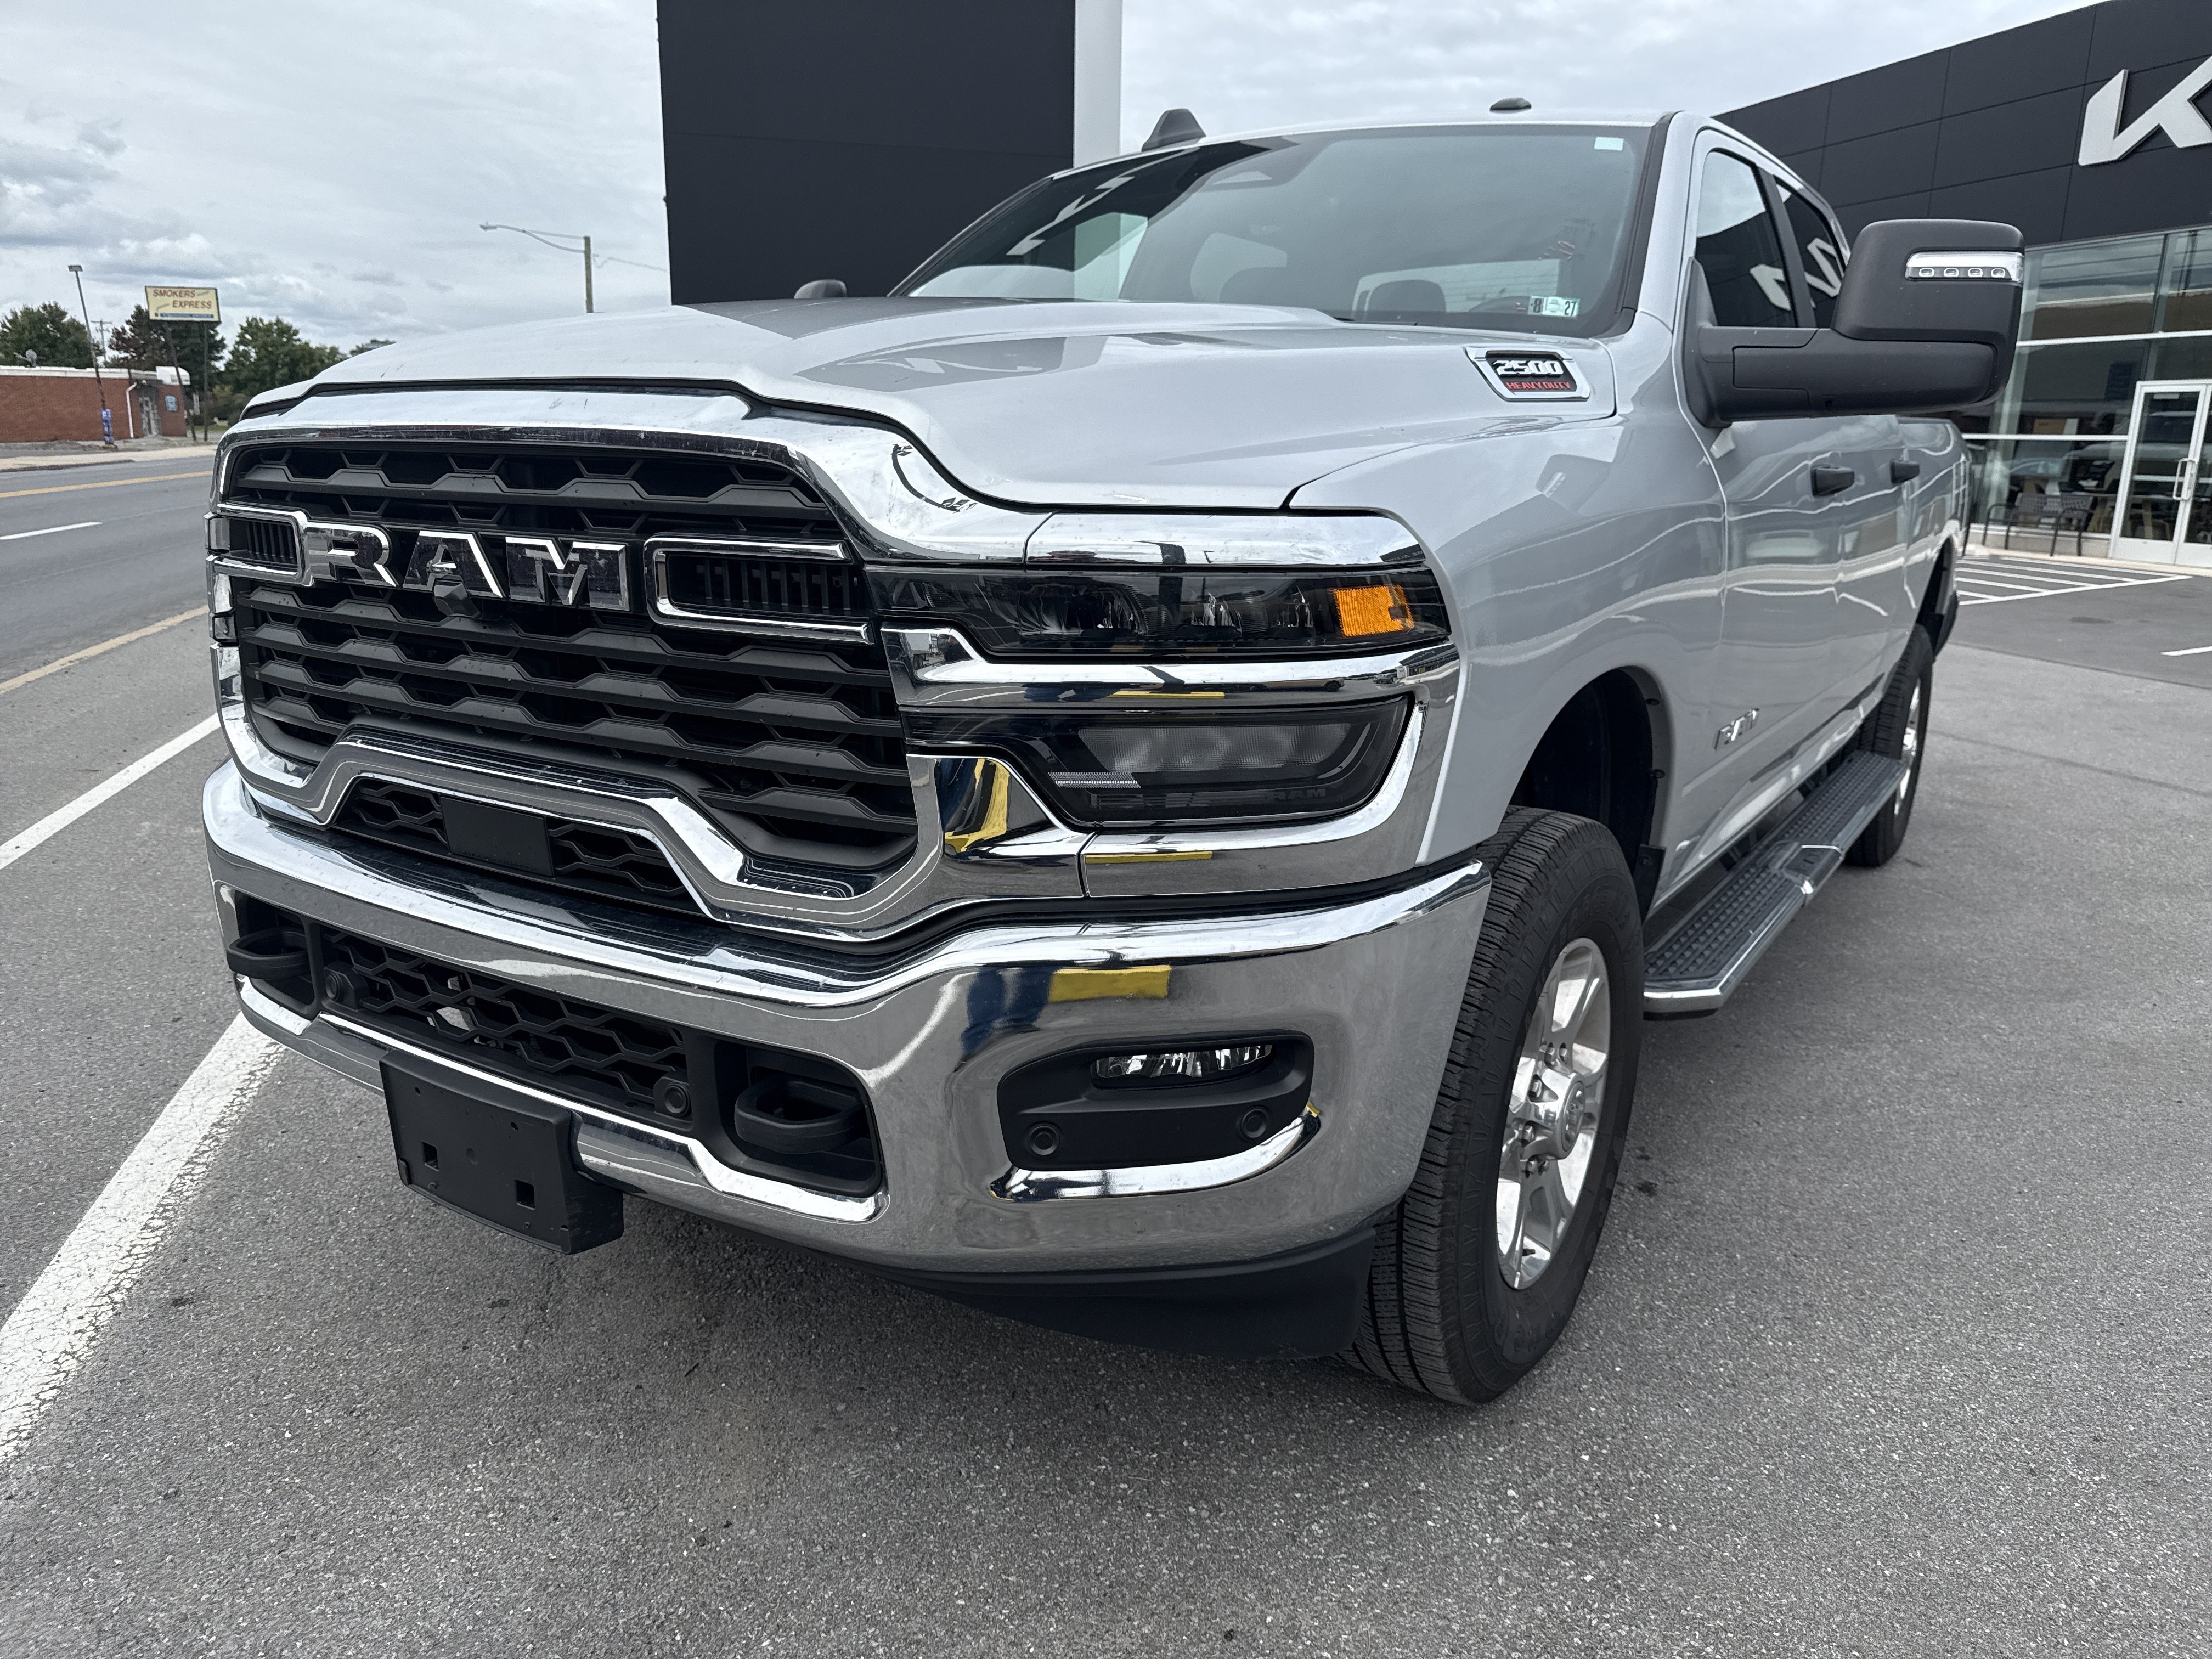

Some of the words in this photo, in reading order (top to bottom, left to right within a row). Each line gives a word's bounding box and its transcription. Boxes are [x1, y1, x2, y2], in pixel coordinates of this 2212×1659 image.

[153, 289, 196, 298] SMOKERS
[172, 300, 212, 309] EXPRESS
[1533, 298, 1543, 313] 8
[1564, 301, 1576, 317] 27
[1492, 359, 1564, 377] 2500
[1505, 381, 1543, 390] HEAVY
[1542, 381, 1571, 390] DUTY
[306, 521, 630, 611] RAM
[1267, 788, 1326, 801] RAM
